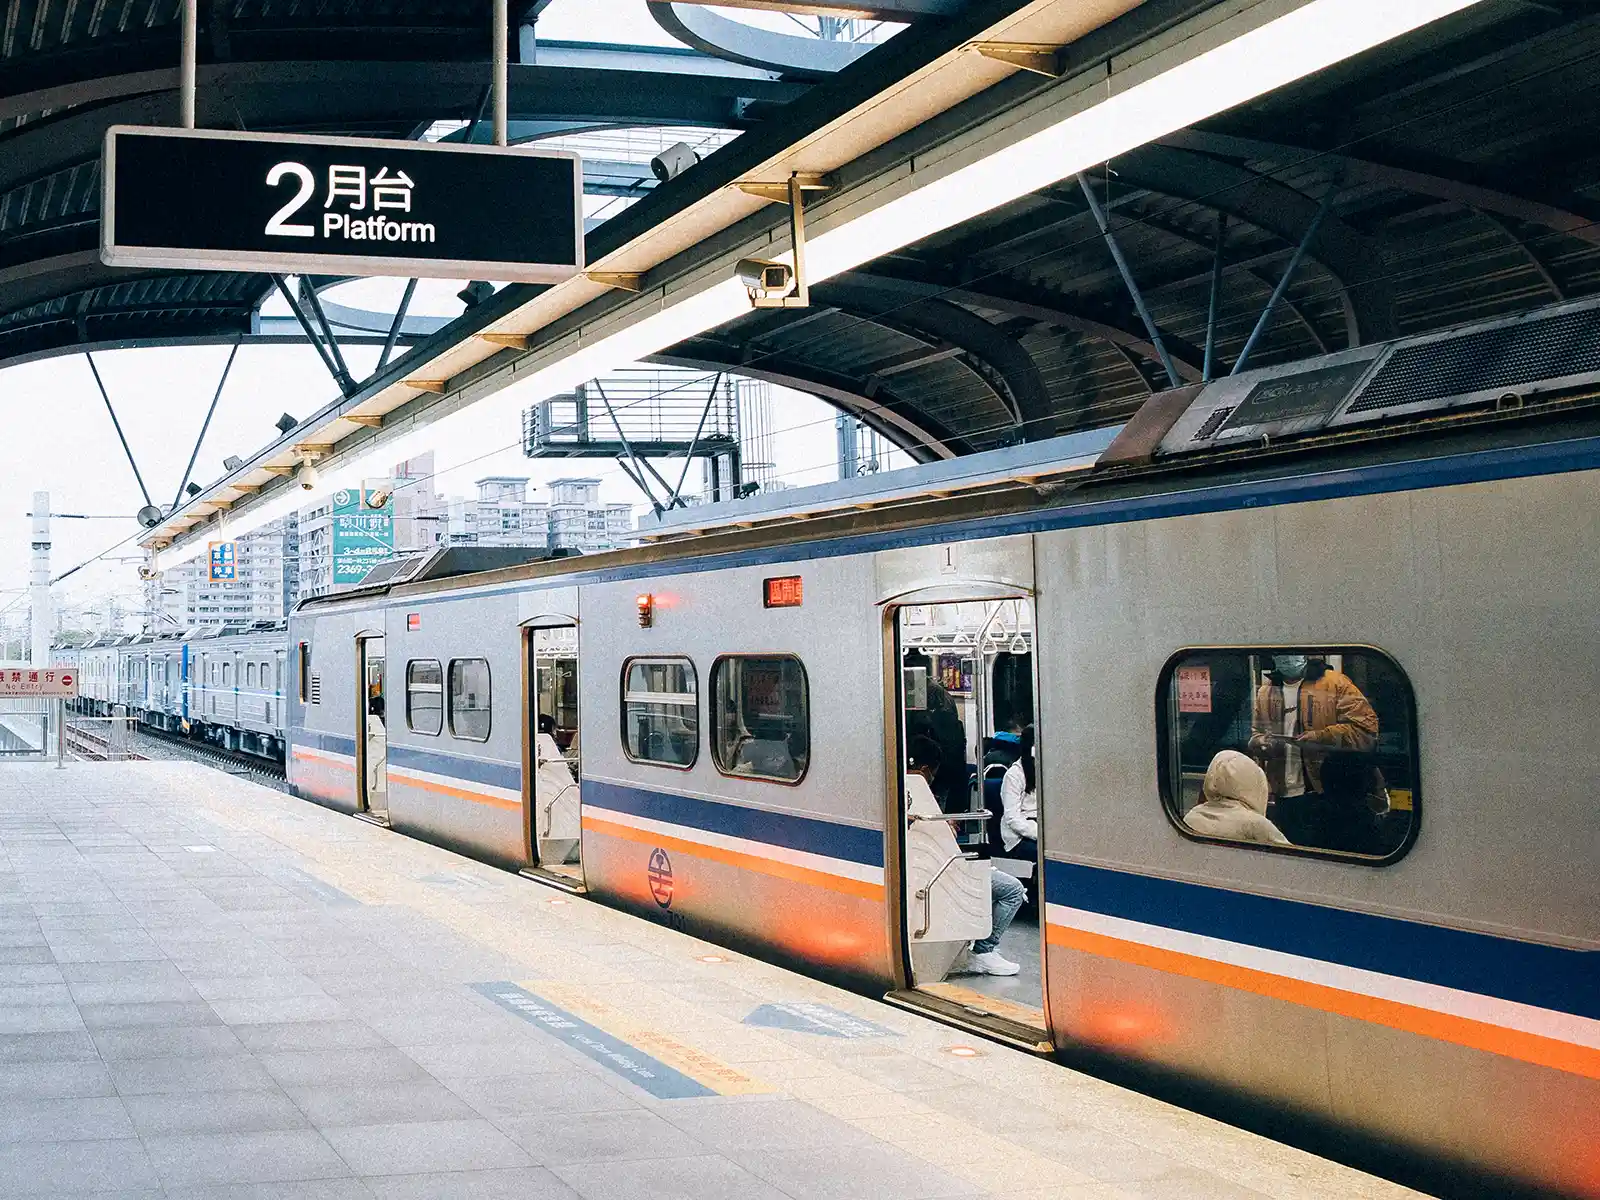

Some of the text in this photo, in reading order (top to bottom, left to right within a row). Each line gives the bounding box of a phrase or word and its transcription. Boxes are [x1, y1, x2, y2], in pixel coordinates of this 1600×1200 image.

[264, 161, 315, 237] 2
[323, 164, 415, 213] 月台
[323, 212, 436, 243] Platform
[20, 683, 44, 691] Entry
